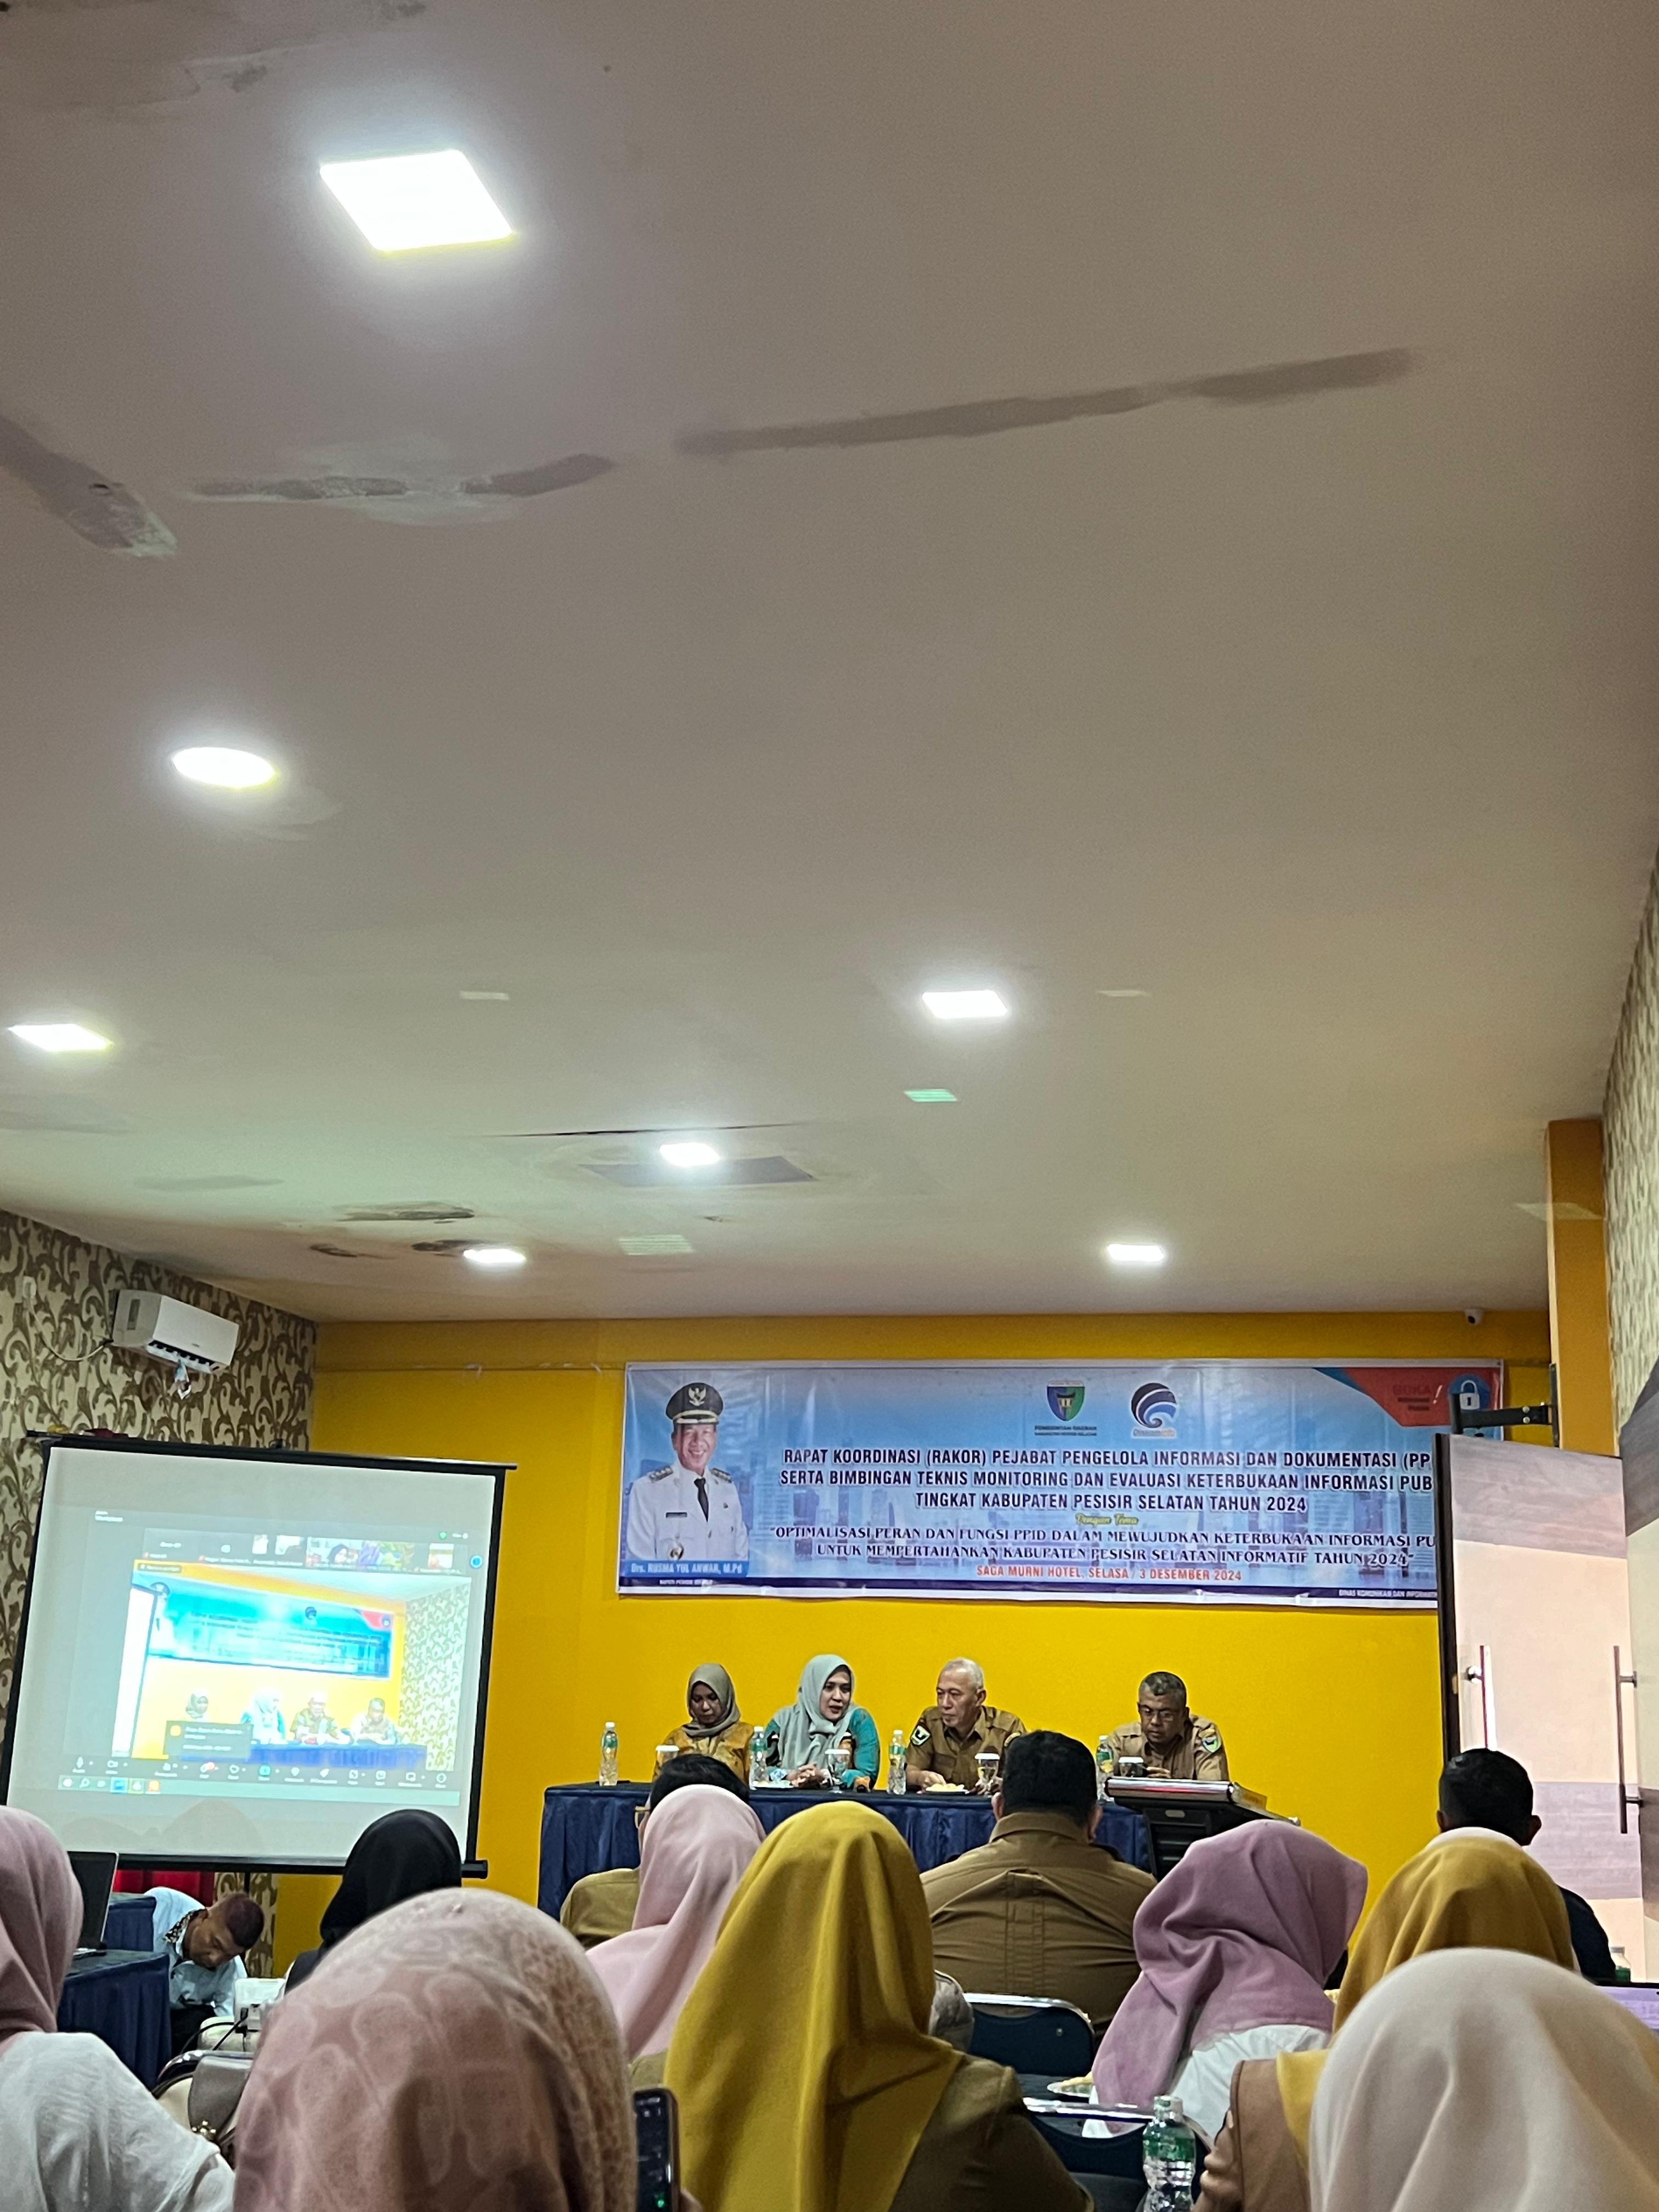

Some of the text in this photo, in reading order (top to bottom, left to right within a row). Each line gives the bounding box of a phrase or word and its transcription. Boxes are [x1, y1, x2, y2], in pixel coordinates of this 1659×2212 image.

[785, 1449, 828, 1463] RAPAT
[833, 1449, 920, 1463] KOORDINASI
[927, 1449, 986, 1468] (RAKOR)
[992, 1450, 1057, 1464] PEJABAT
[1063, 1451, 1148, 1465] PENGELOLA
[1155, 1451, 1240, 1465] INFORMASI
[1246, 1452, 1277, 1466] DAN
[1284, 1452, 1396, 1467] DOKUMENTASI
[781, 1470, 1432, 1490] SERTA BIMBINGAN TEKNIS MONITORING DAN EVALUASI KETERBUKAAN INFORMASI PUB
[916, 1493, 1306, 1511] TINGKAT KABUPATEN PESISIR SELATAN TAHUN 2024
[876, 1528, 920, 1539] PERAN
[926, 1528, 954, 1539] DAN
[961, 1529, 1008, 1540] FUNGSI
[1014, 1530, 1046, 1541] PPID
[1052, 1530, 1102, 1542] DALAM
[1108, 1531, 1207, 1543] MEWUJUDKAN
[1215, 1532, 1323, 1545] KETERBUKAAN
[1330, 1535, 1410, 1547] INFORMASI
[817, 1545, 861, 1555] UNTUK
[867, 1545, 998, 1557] MEMPERTAHANKAN
[1004, 1547, 1085, 1559] KABUPATEN
[1092, 1549, 1146, 1560] PESISIR
[1152, 1550, 1216, 1561] SELATAN
[1222, 1551, 1308, 1563] INFORMATIF
[1316, 1552, 1362, 1564] TAHUN
[977, 1565, 1004, 1576] SAGA
[1008, 1566, 1042, 1576] MURNI
[1089, 1568, 1129, 1579] SELASA
[1139, 1569, 1146, 1579] 3
[1150, 1569, 1208, 1581] DESEMBER
[1214, 1570, 1242, 1581] 2024
